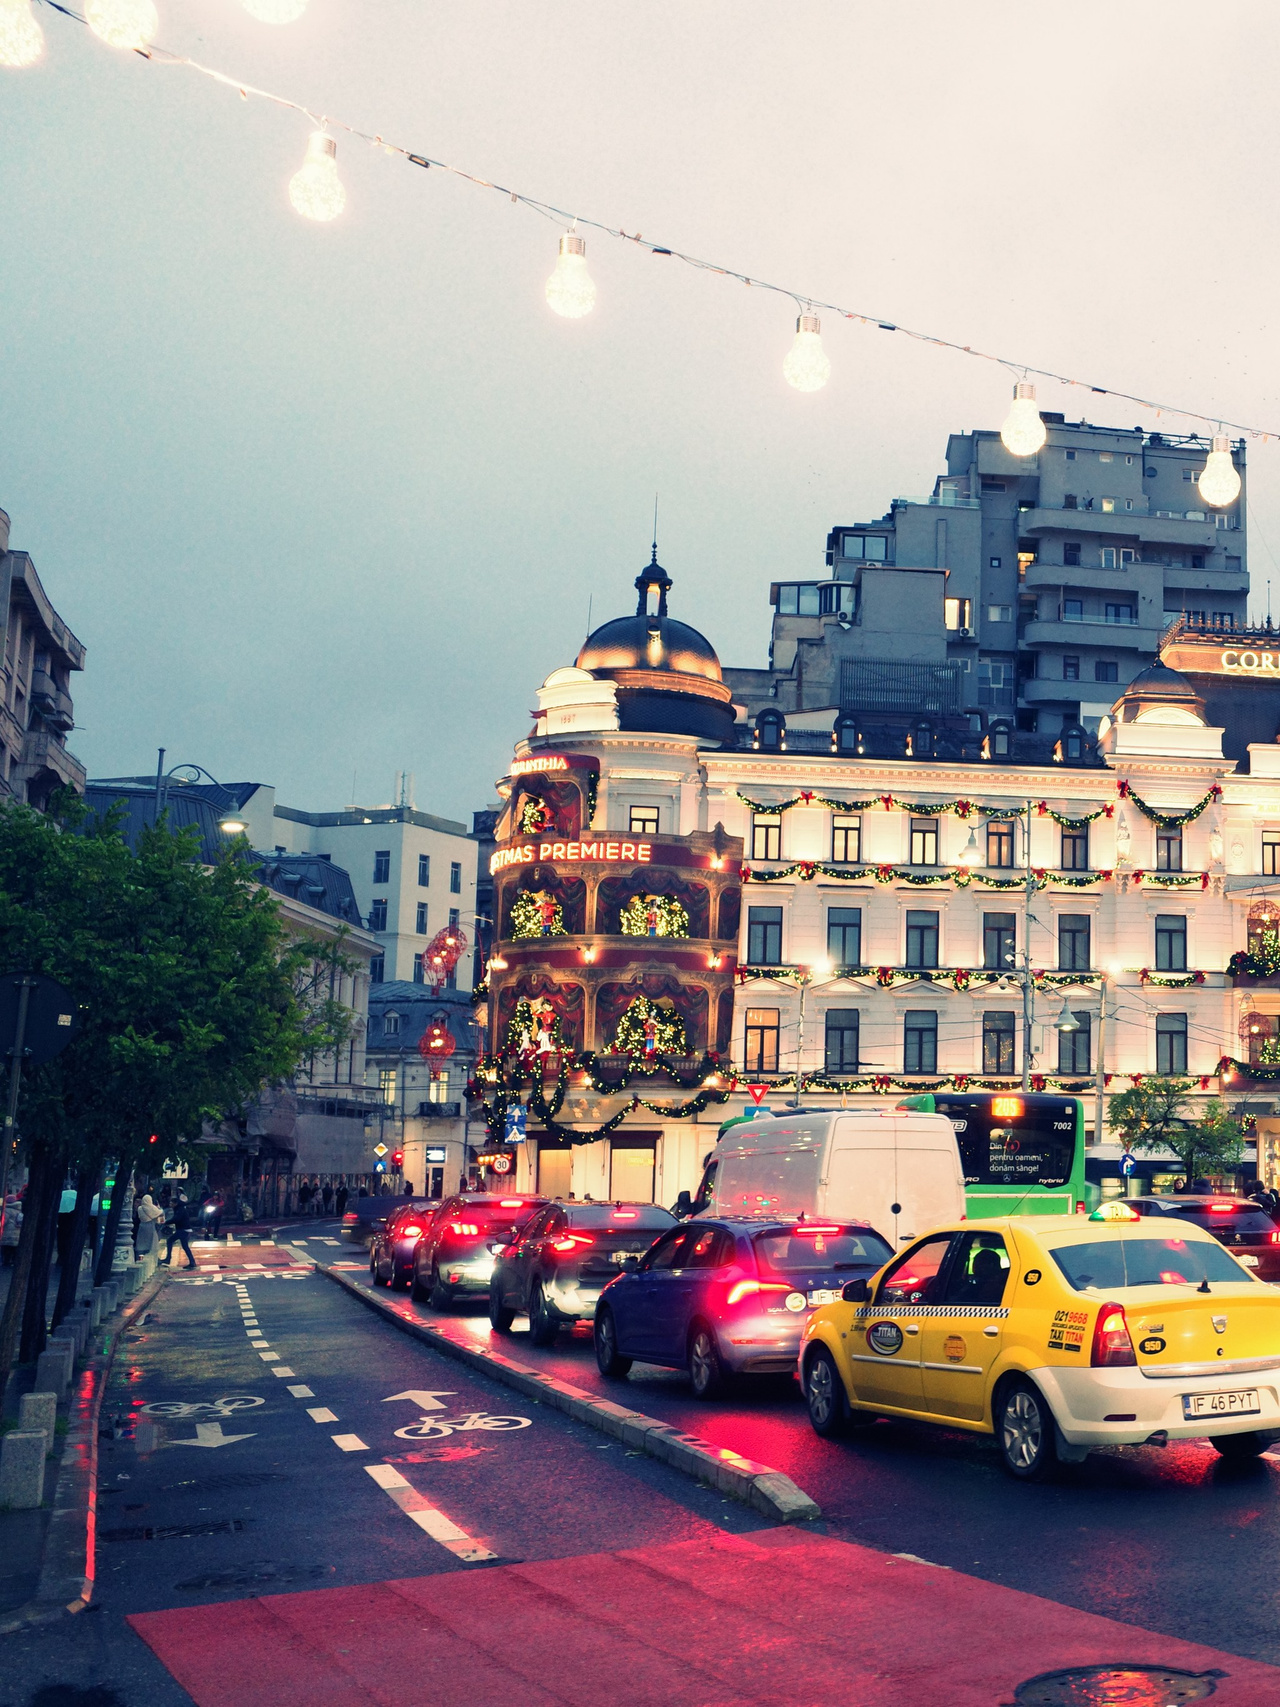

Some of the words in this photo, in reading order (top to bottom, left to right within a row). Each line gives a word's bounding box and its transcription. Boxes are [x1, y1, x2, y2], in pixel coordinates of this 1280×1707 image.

[540, 842, 651, 861] PREMIERE
[995, 1098, 1017, 1116] 205
[1053, 1122, 1072, 1130] 7002
[990, 1142, 1002, 1150] Din
[990, 1154, 1014, 1162] pentru
[497, 1160, 507, 1169] 30
[1026, 1272, 1039, 1283] 950
[877, 1326, 897, 1338] TITAN
[1050, 1329, 1064, 1341] TAXI
[1065, 1331, 1084, 1344] TITAN
[1144, 1341, 1161, 1351] 950
[1193, 1397, 1205, 1412] IF
[1211, 1396, 1226, 1410] 46
[1228, 1393, 1252, 1410] PYT
